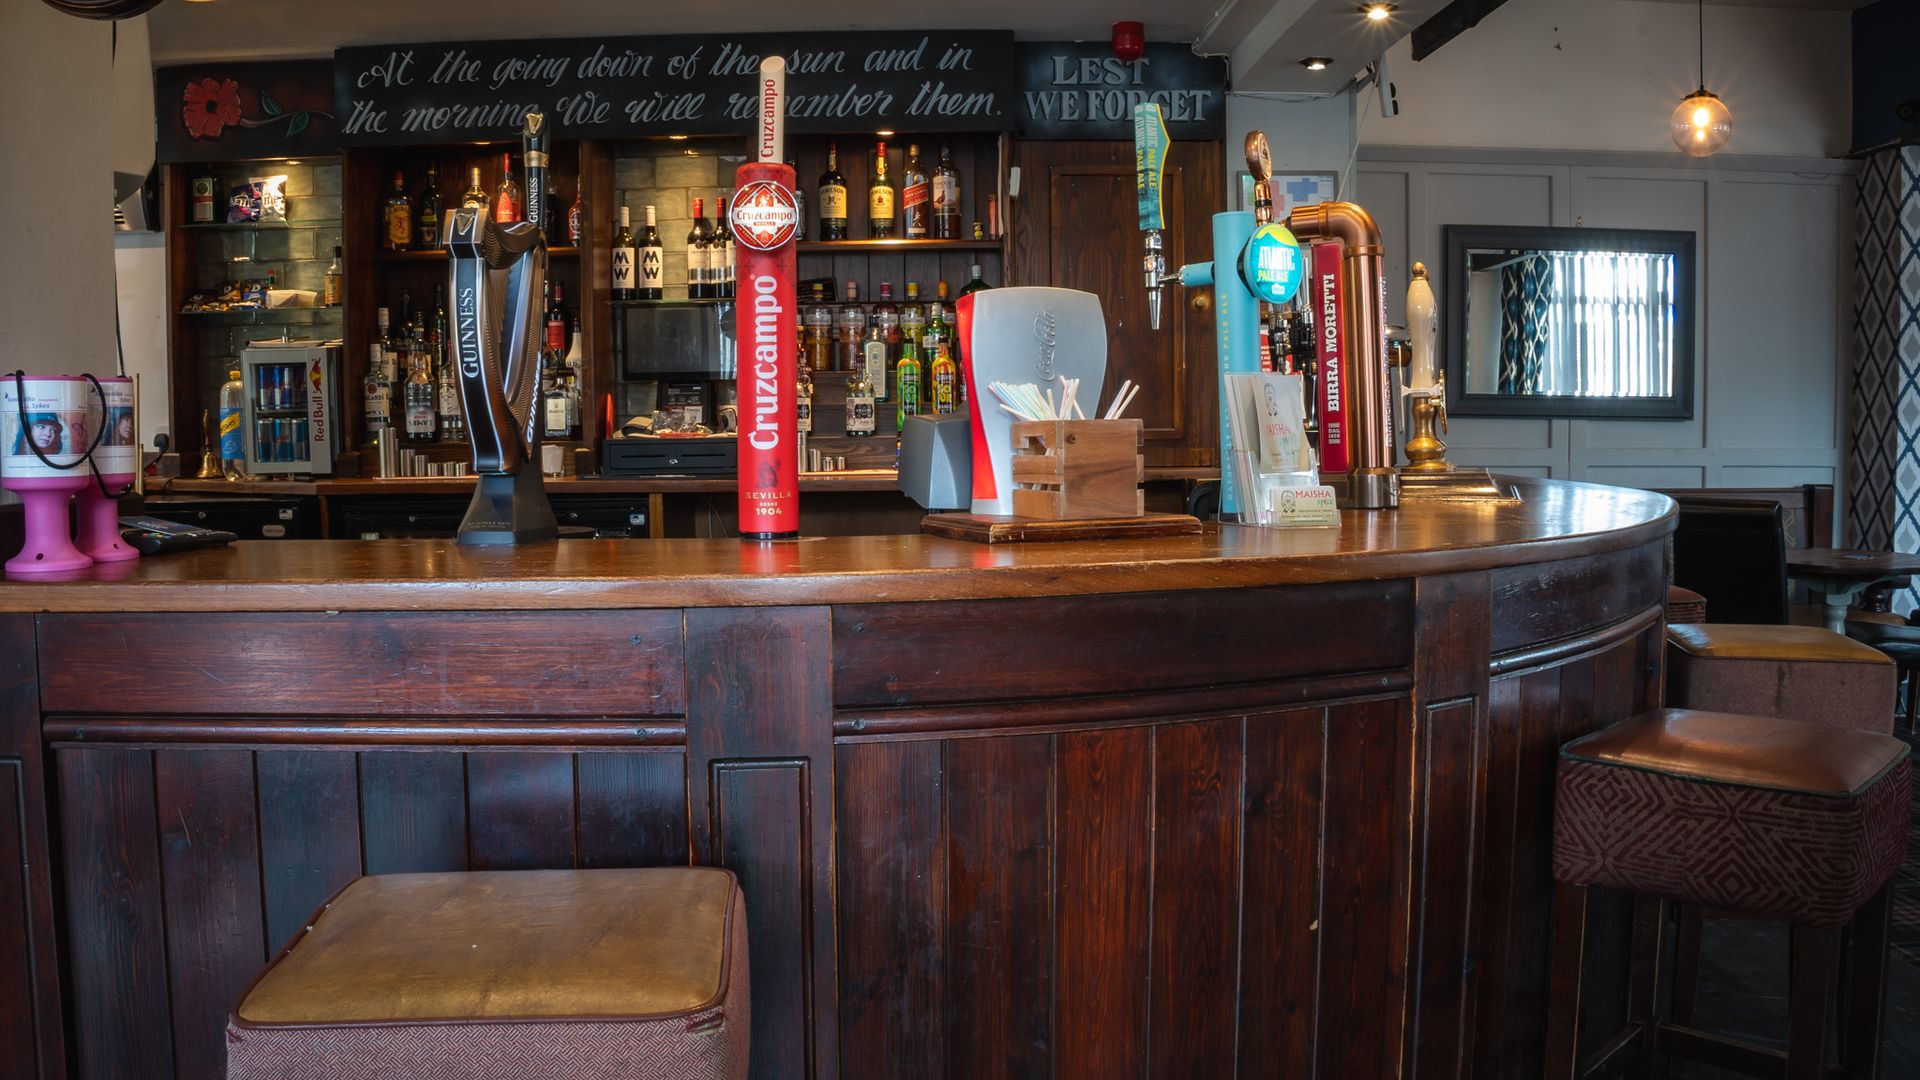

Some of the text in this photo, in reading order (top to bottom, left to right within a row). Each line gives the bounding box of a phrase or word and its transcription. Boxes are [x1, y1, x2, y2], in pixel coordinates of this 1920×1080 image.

[356, 36, 973, 91] At the going down of the sun and in
[1051, 56, 1150, 85] LEST
[341, 80, 1002, 136] the morning We will reember them.
[1024, 89, 1212, 121] WE FORGET
[760, 79, 777, 159] Cruzcampo
[1137, 148, 1146, 170] PALE
[1147, 148, 1157, 171] PALE
[1137, 170, 1145, 190] ALE
[1149, 171, 1158, 188] ALE
[529, 177, 539, 223] GUINNESS
[736, 210, 793, 222] Cruzcampo
[613, 251, 630, 264] M
[643, 250, 660, 263] M
[1257, 269, 1289, 283] PALE ALE
[458, 287, 480, 379] GUINNESS
[1322, 273, 1340, 412] BIRRA MORETTI
[747, 274, 783, 451] Cruzcampo
[526, 351, 542, 443] GUINNESS
[311, 396, 325, 442] Red Bull
[745, 491, 792, 500] SEVILLA
[1295, 490, 1332, 498] MAISHA
[755, 507, 783, 516] 1904
